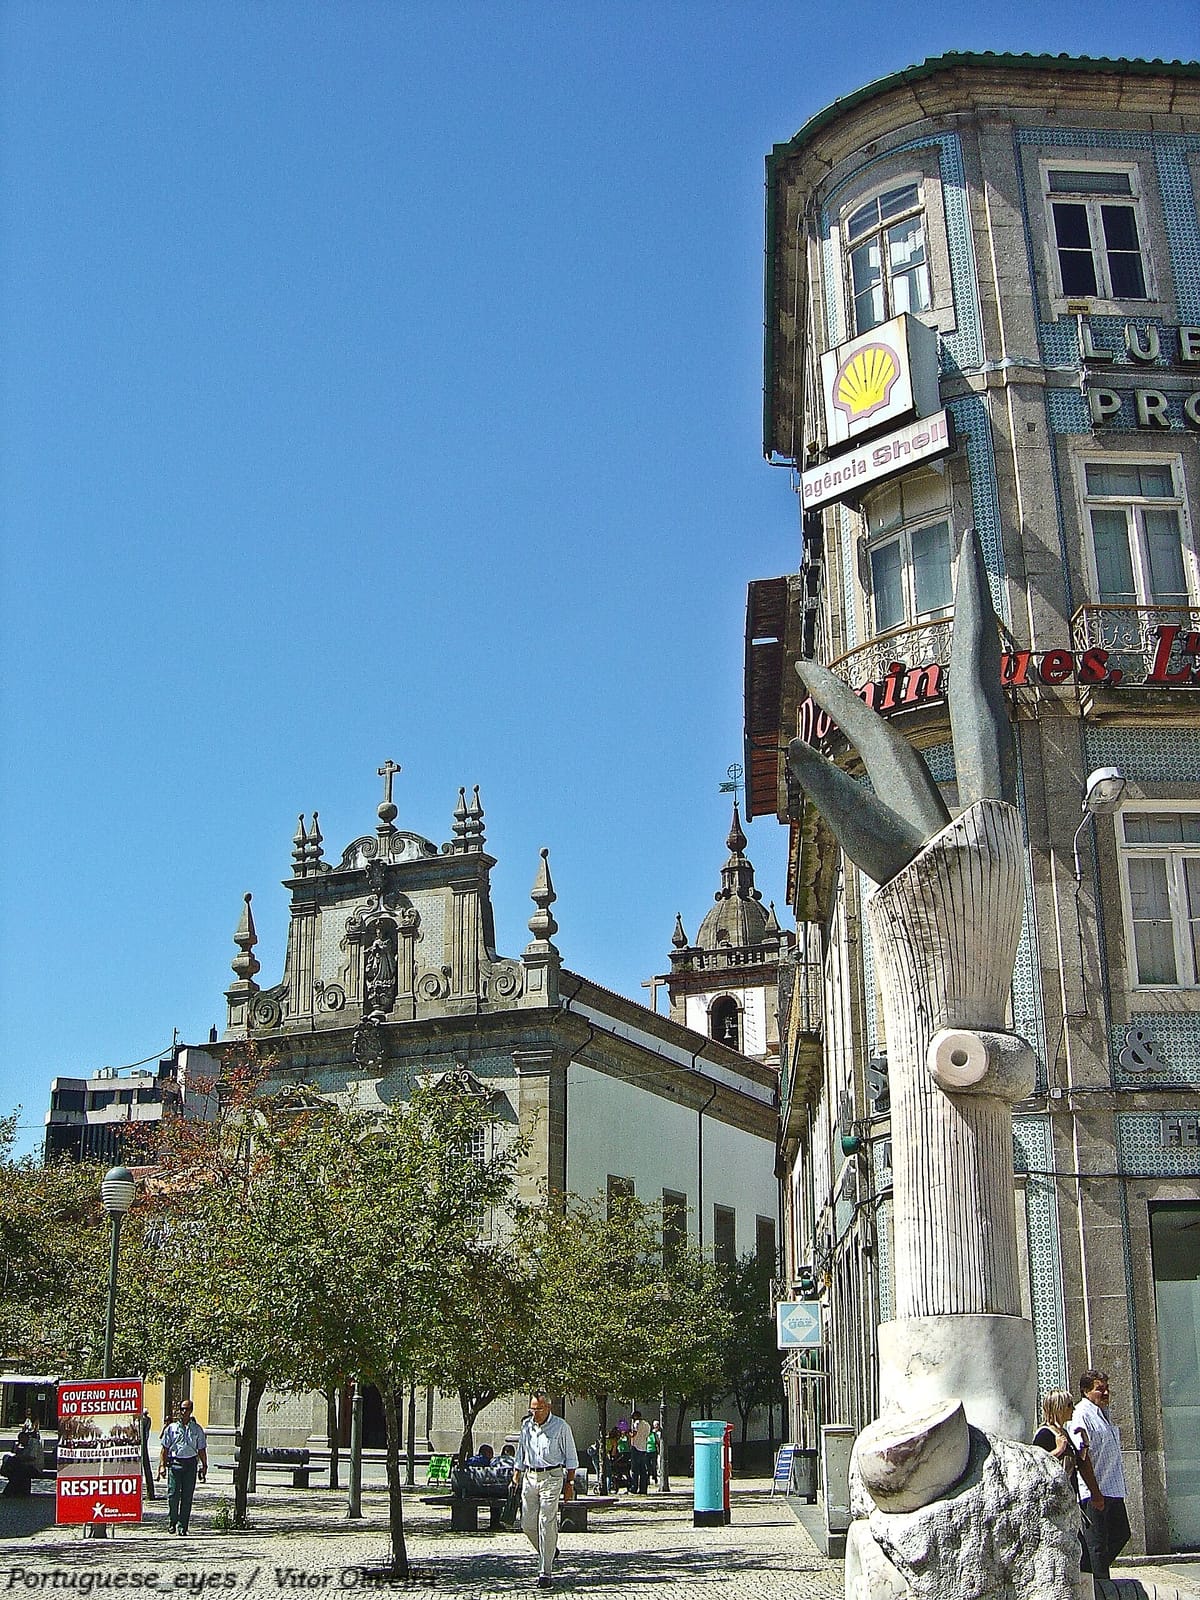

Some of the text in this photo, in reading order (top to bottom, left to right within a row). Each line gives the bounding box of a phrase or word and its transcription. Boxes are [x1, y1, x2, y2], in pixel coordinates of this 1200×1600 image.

[804, 419, 946, 498] agência Shell
[1118, 1026, 1167, 1073] &
[62, 1388, 138, 1401] GOVERNO FALHA
[62, 1400, 138, 1414] NO ESSENCIAL
[60, 1478, 137, 1497] RESPEITO!
